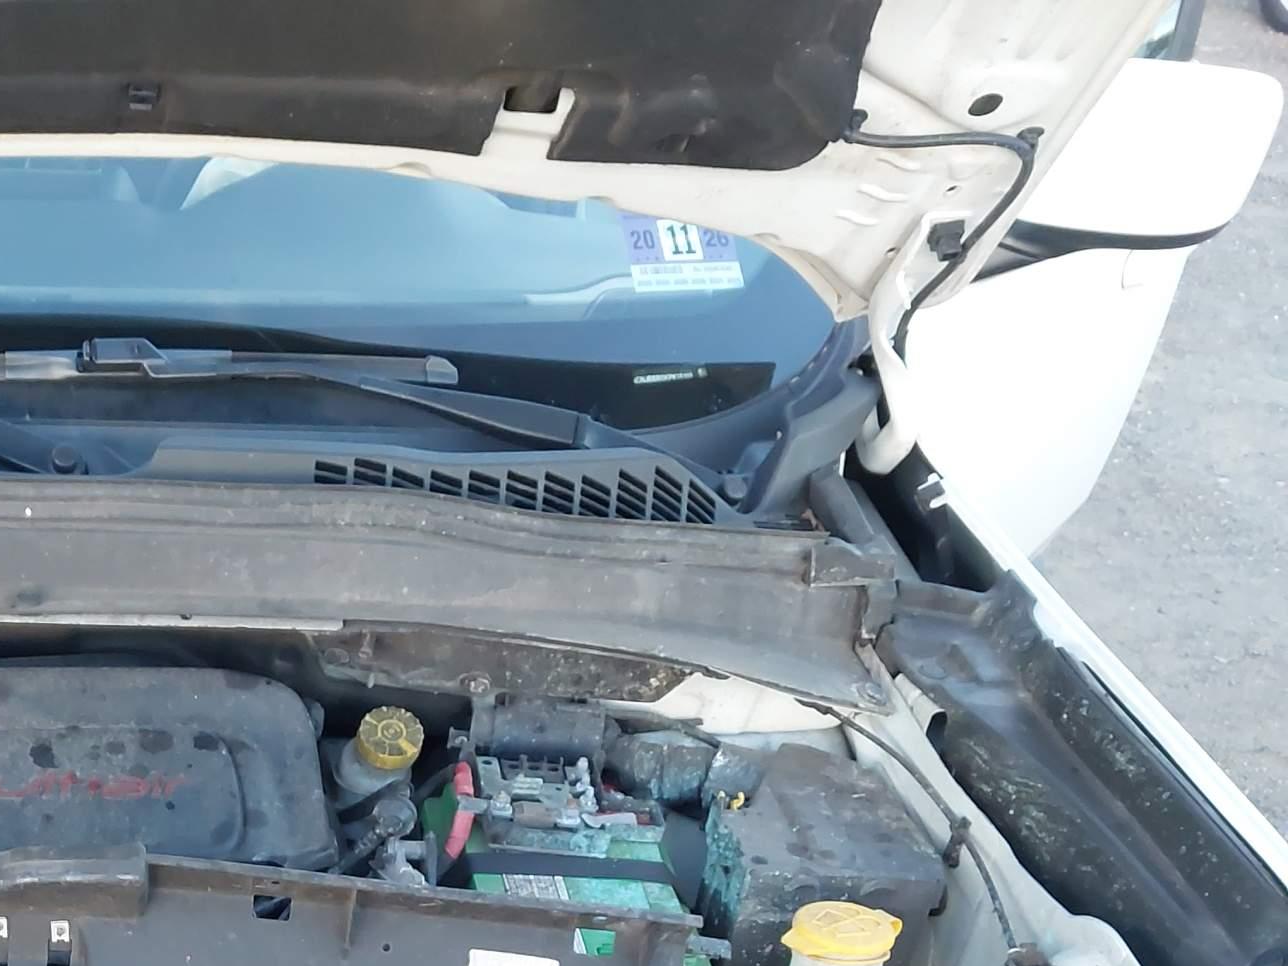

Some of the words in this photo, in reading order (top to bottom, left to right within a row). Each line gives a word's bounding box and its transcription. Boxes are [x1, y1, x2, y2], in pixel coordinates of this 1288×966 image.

[630, 229, 656, 250] 20
[666, 224, 697, 255] 11
[703, 229, 730, 248] 26
